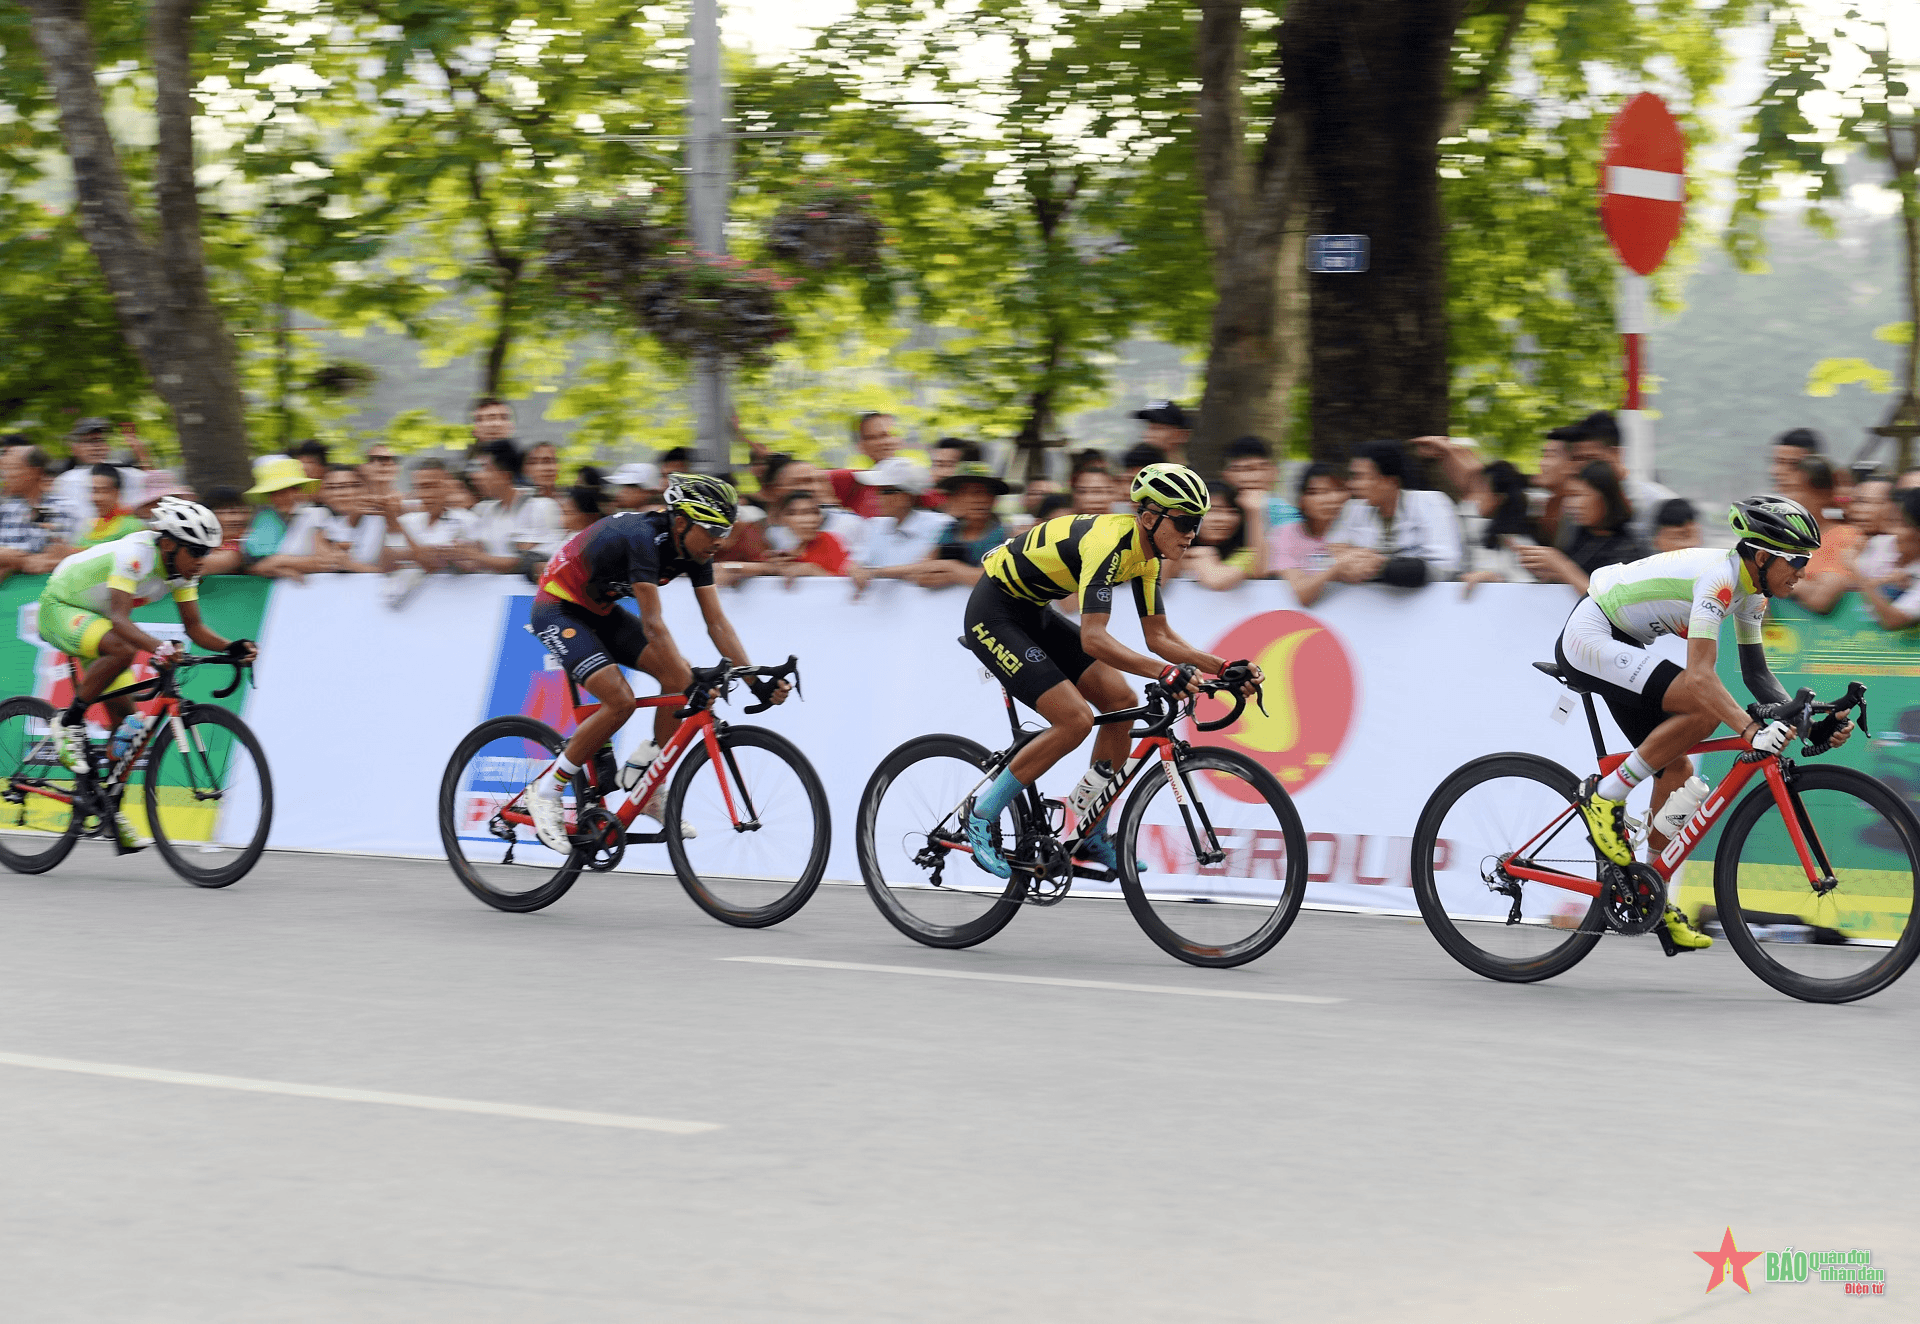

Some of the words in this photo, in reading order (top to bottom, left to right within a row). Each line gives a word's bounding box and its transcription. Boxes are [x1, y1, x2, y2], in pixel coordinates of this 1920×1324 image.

[630, 738, 679, 806] BMC
[1163, 762, 1183, 804] Sunweb
[1661, 786, 1726, 868] BMC
